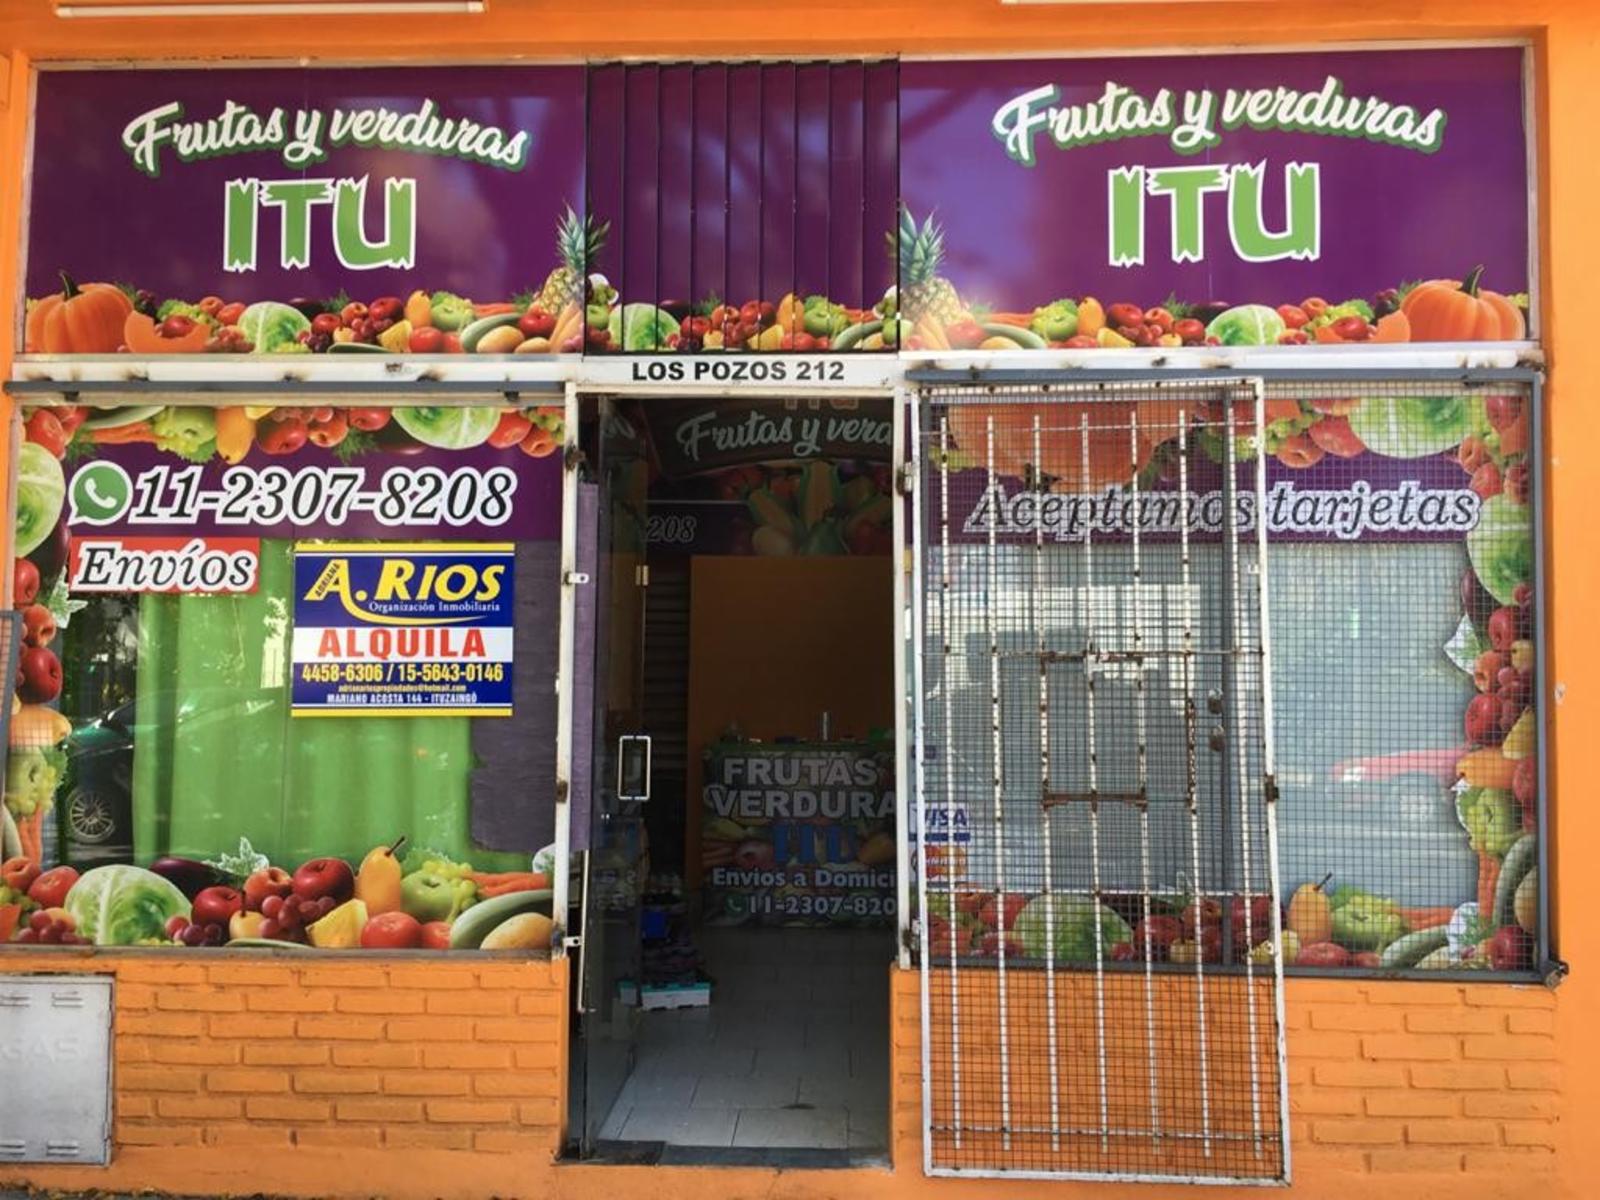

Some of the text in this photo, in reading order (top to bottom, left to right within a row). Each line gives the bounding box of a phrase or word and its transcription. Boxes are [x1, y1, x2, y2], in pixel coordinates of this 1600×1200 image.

[122, 98, 530, 174] Frutas y verduras
[992, 75, 1446, 164] Frutas y verduras
[223, 175, 417, 273] ITU
[1108, 159, 1320, 269] ITU
[632, 361, 845, 381] LOS POZOS 212
[676, 409, 794, 461] Frutas
[793, 414, 821, 456] y
[131, 467, 515, 525] 11-2307-8208
[965, 480, 1481, 540] Aceptamos tarjetas
[76, 543, 254, 590] Envíos
[368, 601, 501, 614] Organización Inmobiliaria
[317, 628, 487, 660] ALQUILA
[302, 663, 384, 682] 4458-6306
[398, 663, 504, 682] 15-5643-0146
[327, 693, 368, 704] MARIANO
[370, 693, 403, 704] ACOSTA
[723, 756, 880, 786] FRUTAS
[713, 789, 896, 819] VERDURA
[712, 867, 784, 888] Envios
[794, 872, 808, 887] a
